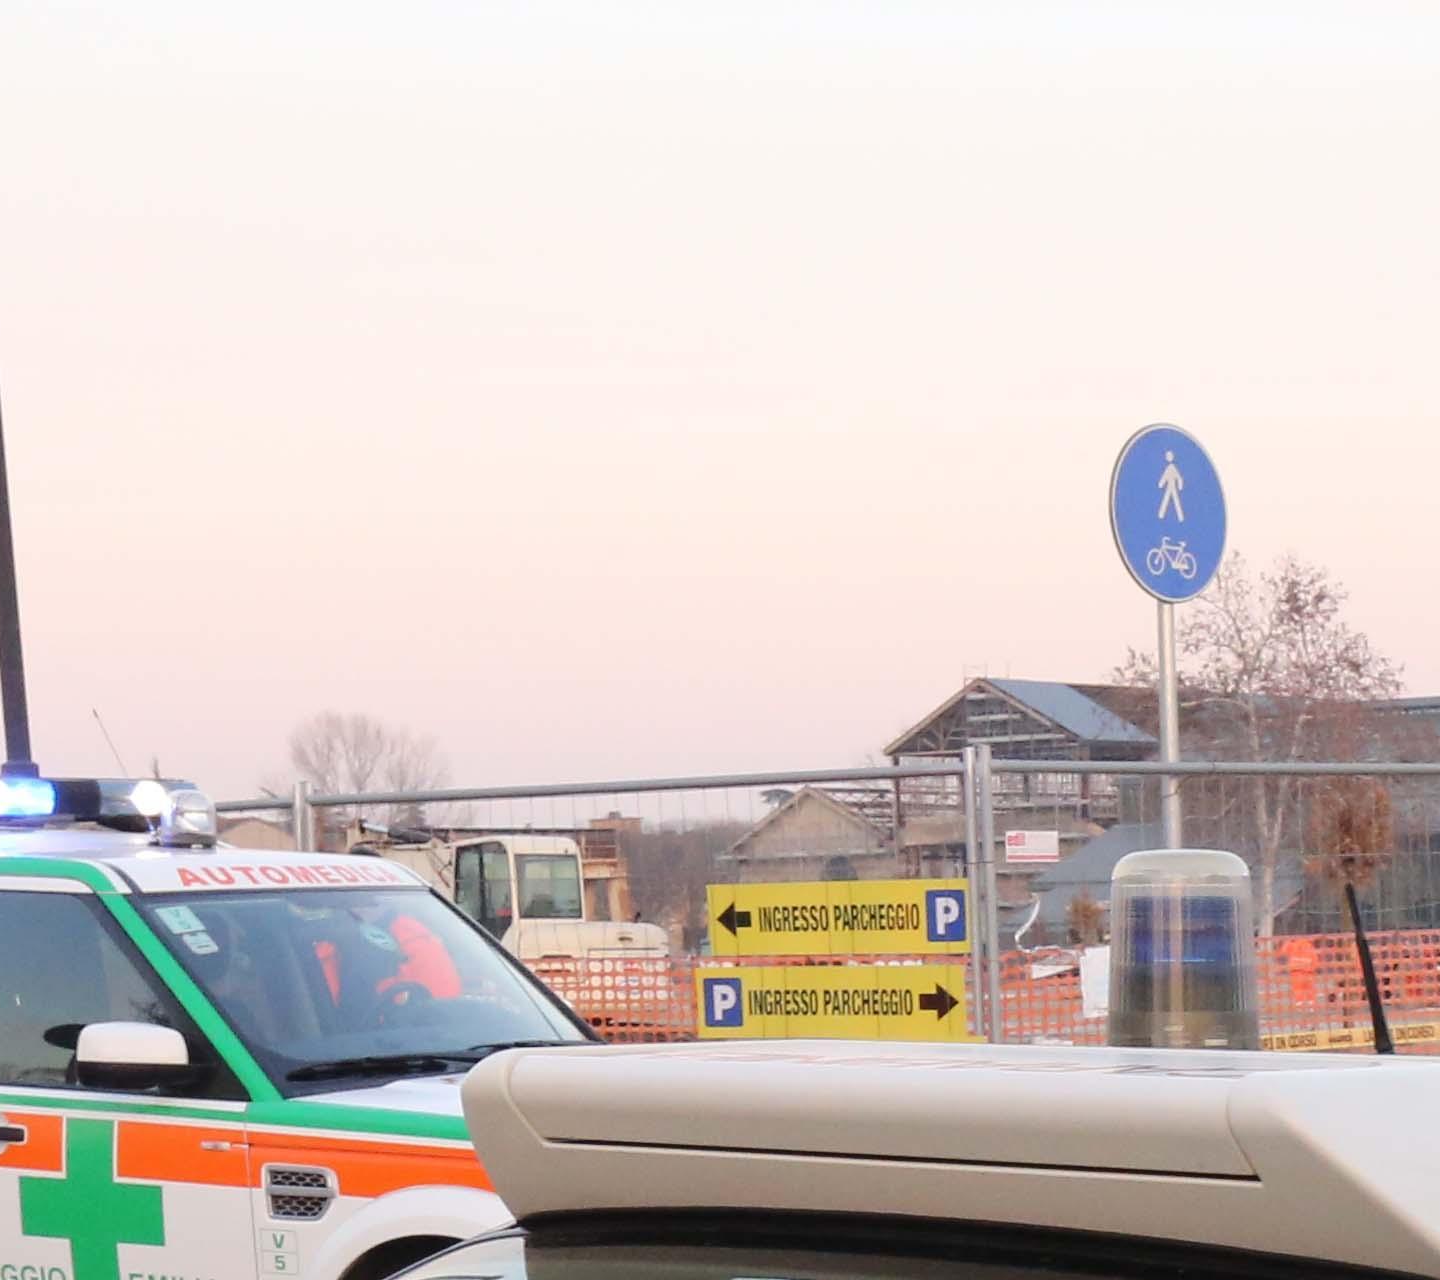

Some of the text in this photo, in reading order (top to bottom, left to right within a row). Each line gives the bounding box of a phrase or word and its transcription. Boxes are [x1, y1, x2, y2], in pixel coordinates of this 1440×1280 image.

[176, 865, 400, 888] AUTOMEDICA
[758, 896, 960, 935] INGRESSO PARCHEGGIO P
[712, 984, 913, 1021] P INGRESSO PARCHEGGIO
[1287, 1033, 1317, 1048] CORSO
[272, 1232, 285, 1250] V
[274, 1255, 286, 1271] 5
